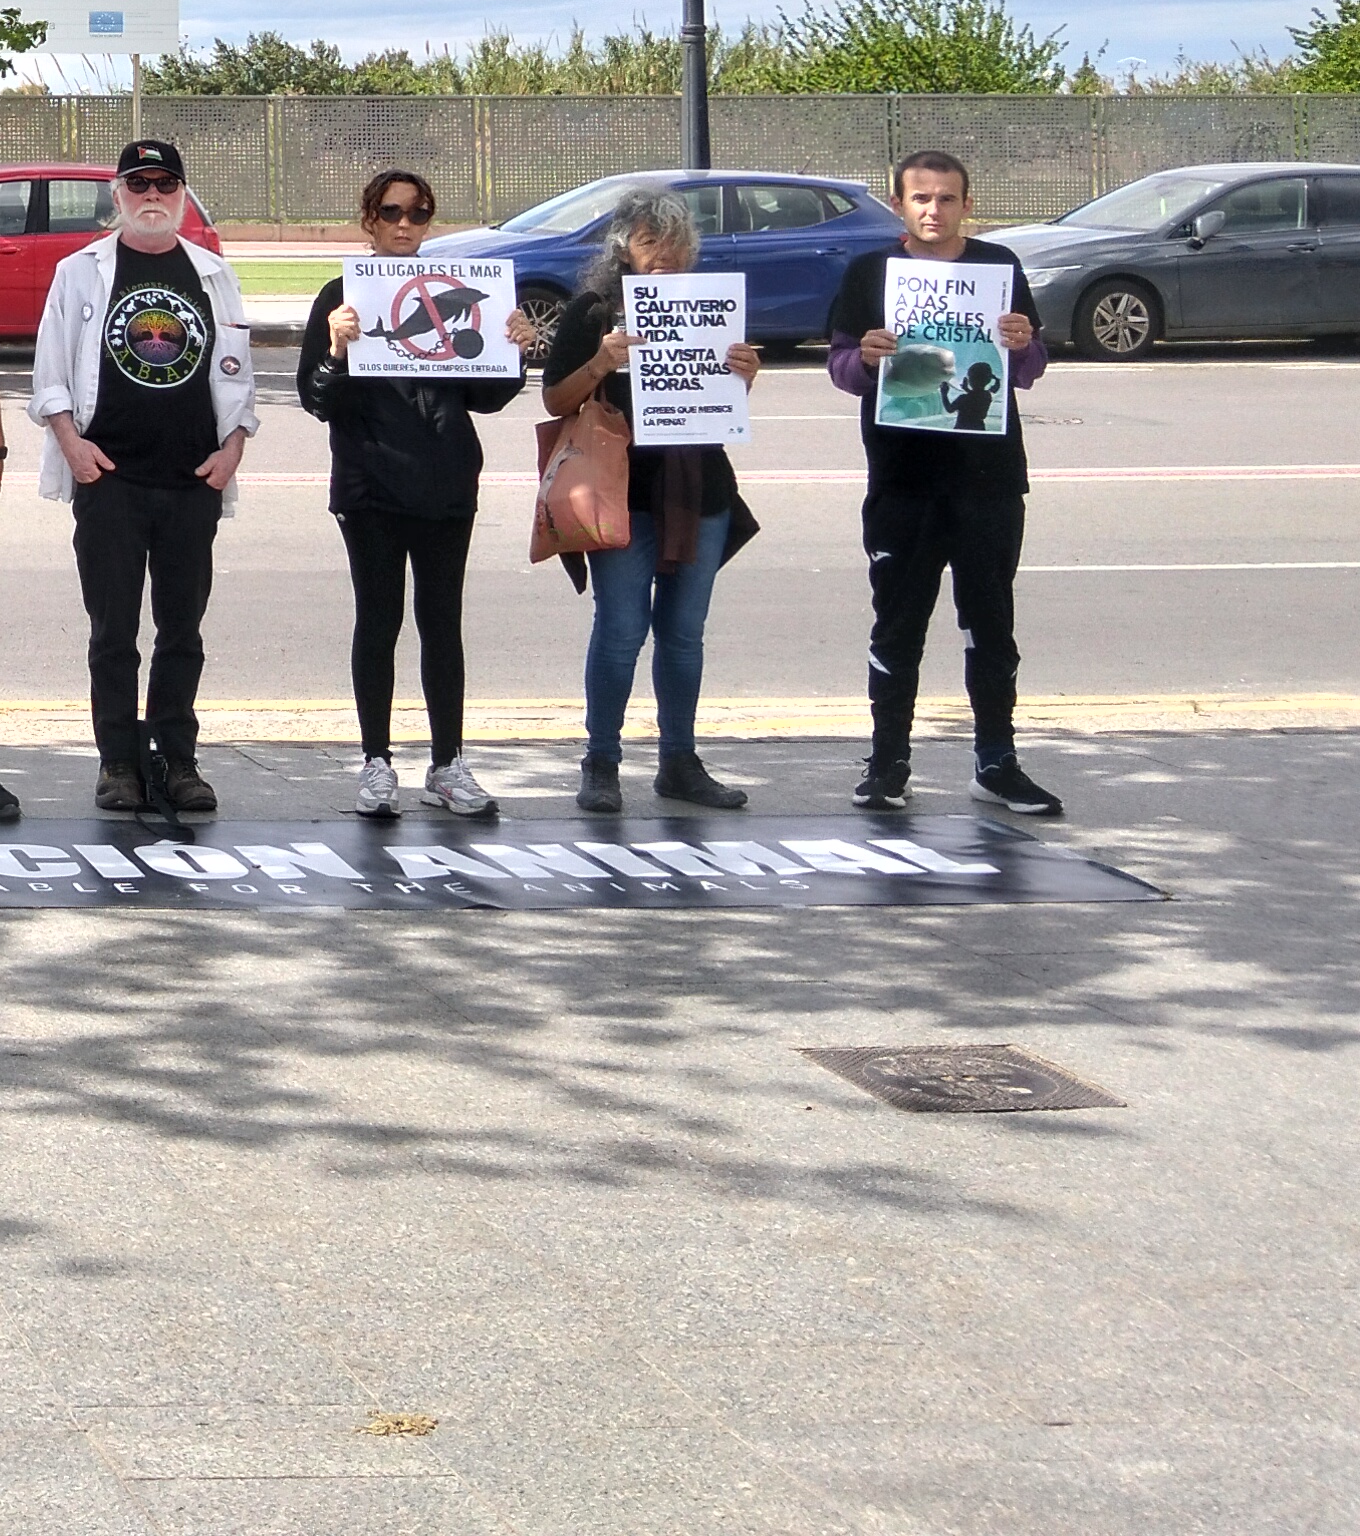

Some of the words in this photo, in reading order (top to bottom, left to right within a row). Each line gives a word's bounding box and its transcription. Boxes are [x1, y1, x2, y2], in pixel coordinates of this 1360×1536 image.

[355, 263, 374, 276] SU
[378, 264, 425, 277] LUGAR
[429, 264, 447, 277] ES
[451, 264, 466, 277] EL
[470, 265, 502, 278] MAR
[633, 286, 658, 300] SU
[897, 276, 938, 294] PON
[945, 279, 975, 296] FIN
[634, 299, 737, 314] CAUTIVERIO
[896, 293, 908, 307] A
[913, 294, 948, 311] LAS
[636, 314, 688, 328] DURA
[690, 314, 727, 327] UNA
[894, 307, 985, 328] CARCELES
[636, 329, 684, 342] VIDA.
[894, 323, 916, 339] DE
[923, 325, 993, 343] CRISTAL
[638, 349, 662, 363] TU
[665, 348, 717, 362] VISITA
[419, 364, 430, 372] NO
[431, 364, 470, 372] COMPRES
[471, 364, 508, 373] ENTRADA
[639, 363, 687, 377] SOLO
[689, 362, 731, 376] UNAS
[641, 377, 704, 392] HORAS.
[677, 405, 697, 414] QUE
[698, 404, 734, 414] MERECE
[643, 418, 656, 426] LA
[656, 418, 687, 426] PENA?
[382, 839, 1002, 879] ANIMAL
[188, 882, 307, 895] FOR
[350, 881, 472, 894] THE
[521, 878, 810, 893] ANIMALS
